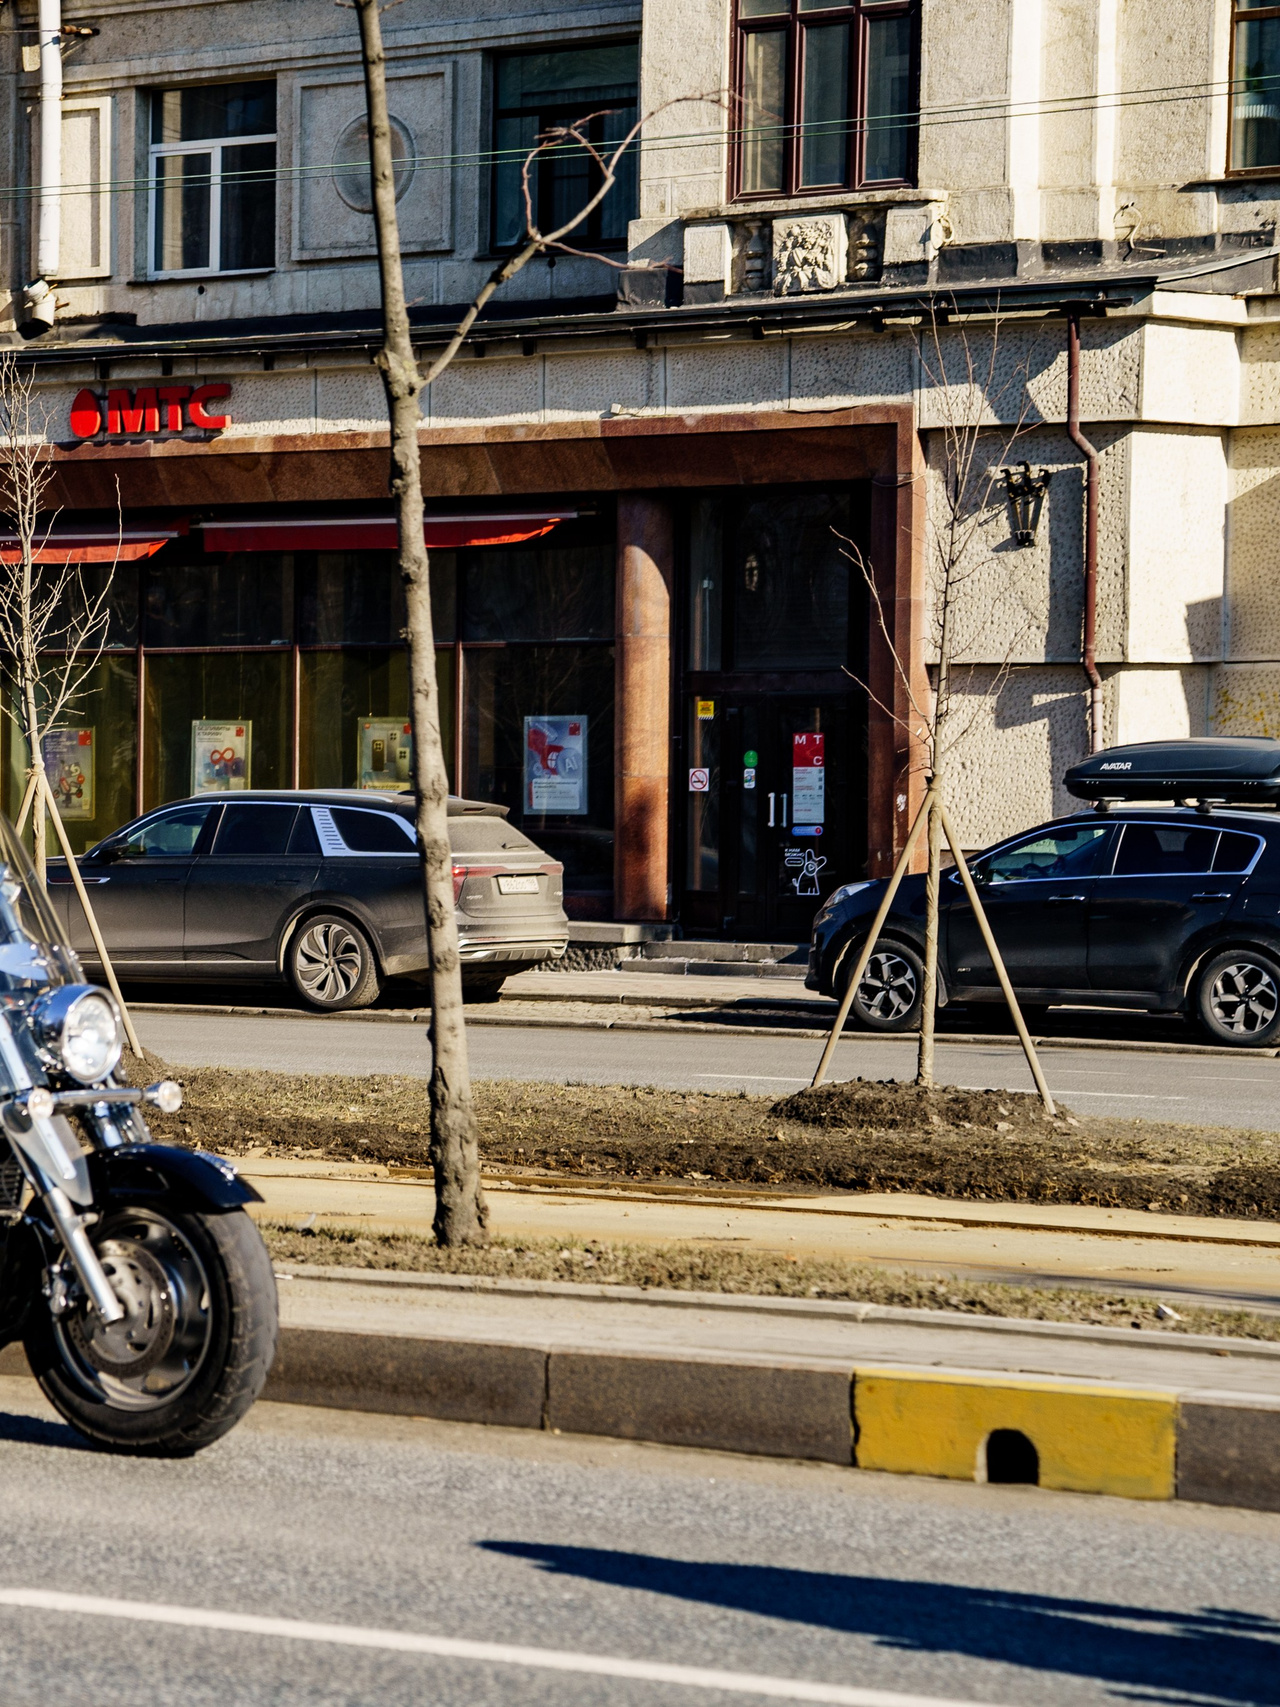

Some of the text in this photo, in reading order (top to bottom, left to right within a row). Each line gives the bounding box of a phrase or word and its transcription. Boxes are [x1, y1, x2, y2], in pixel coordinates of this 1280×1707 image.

[108, 383, 232, 434] МТС
[565, 756, 579, 773] AI
[1099, 762, 1132, 771] AVATAR
